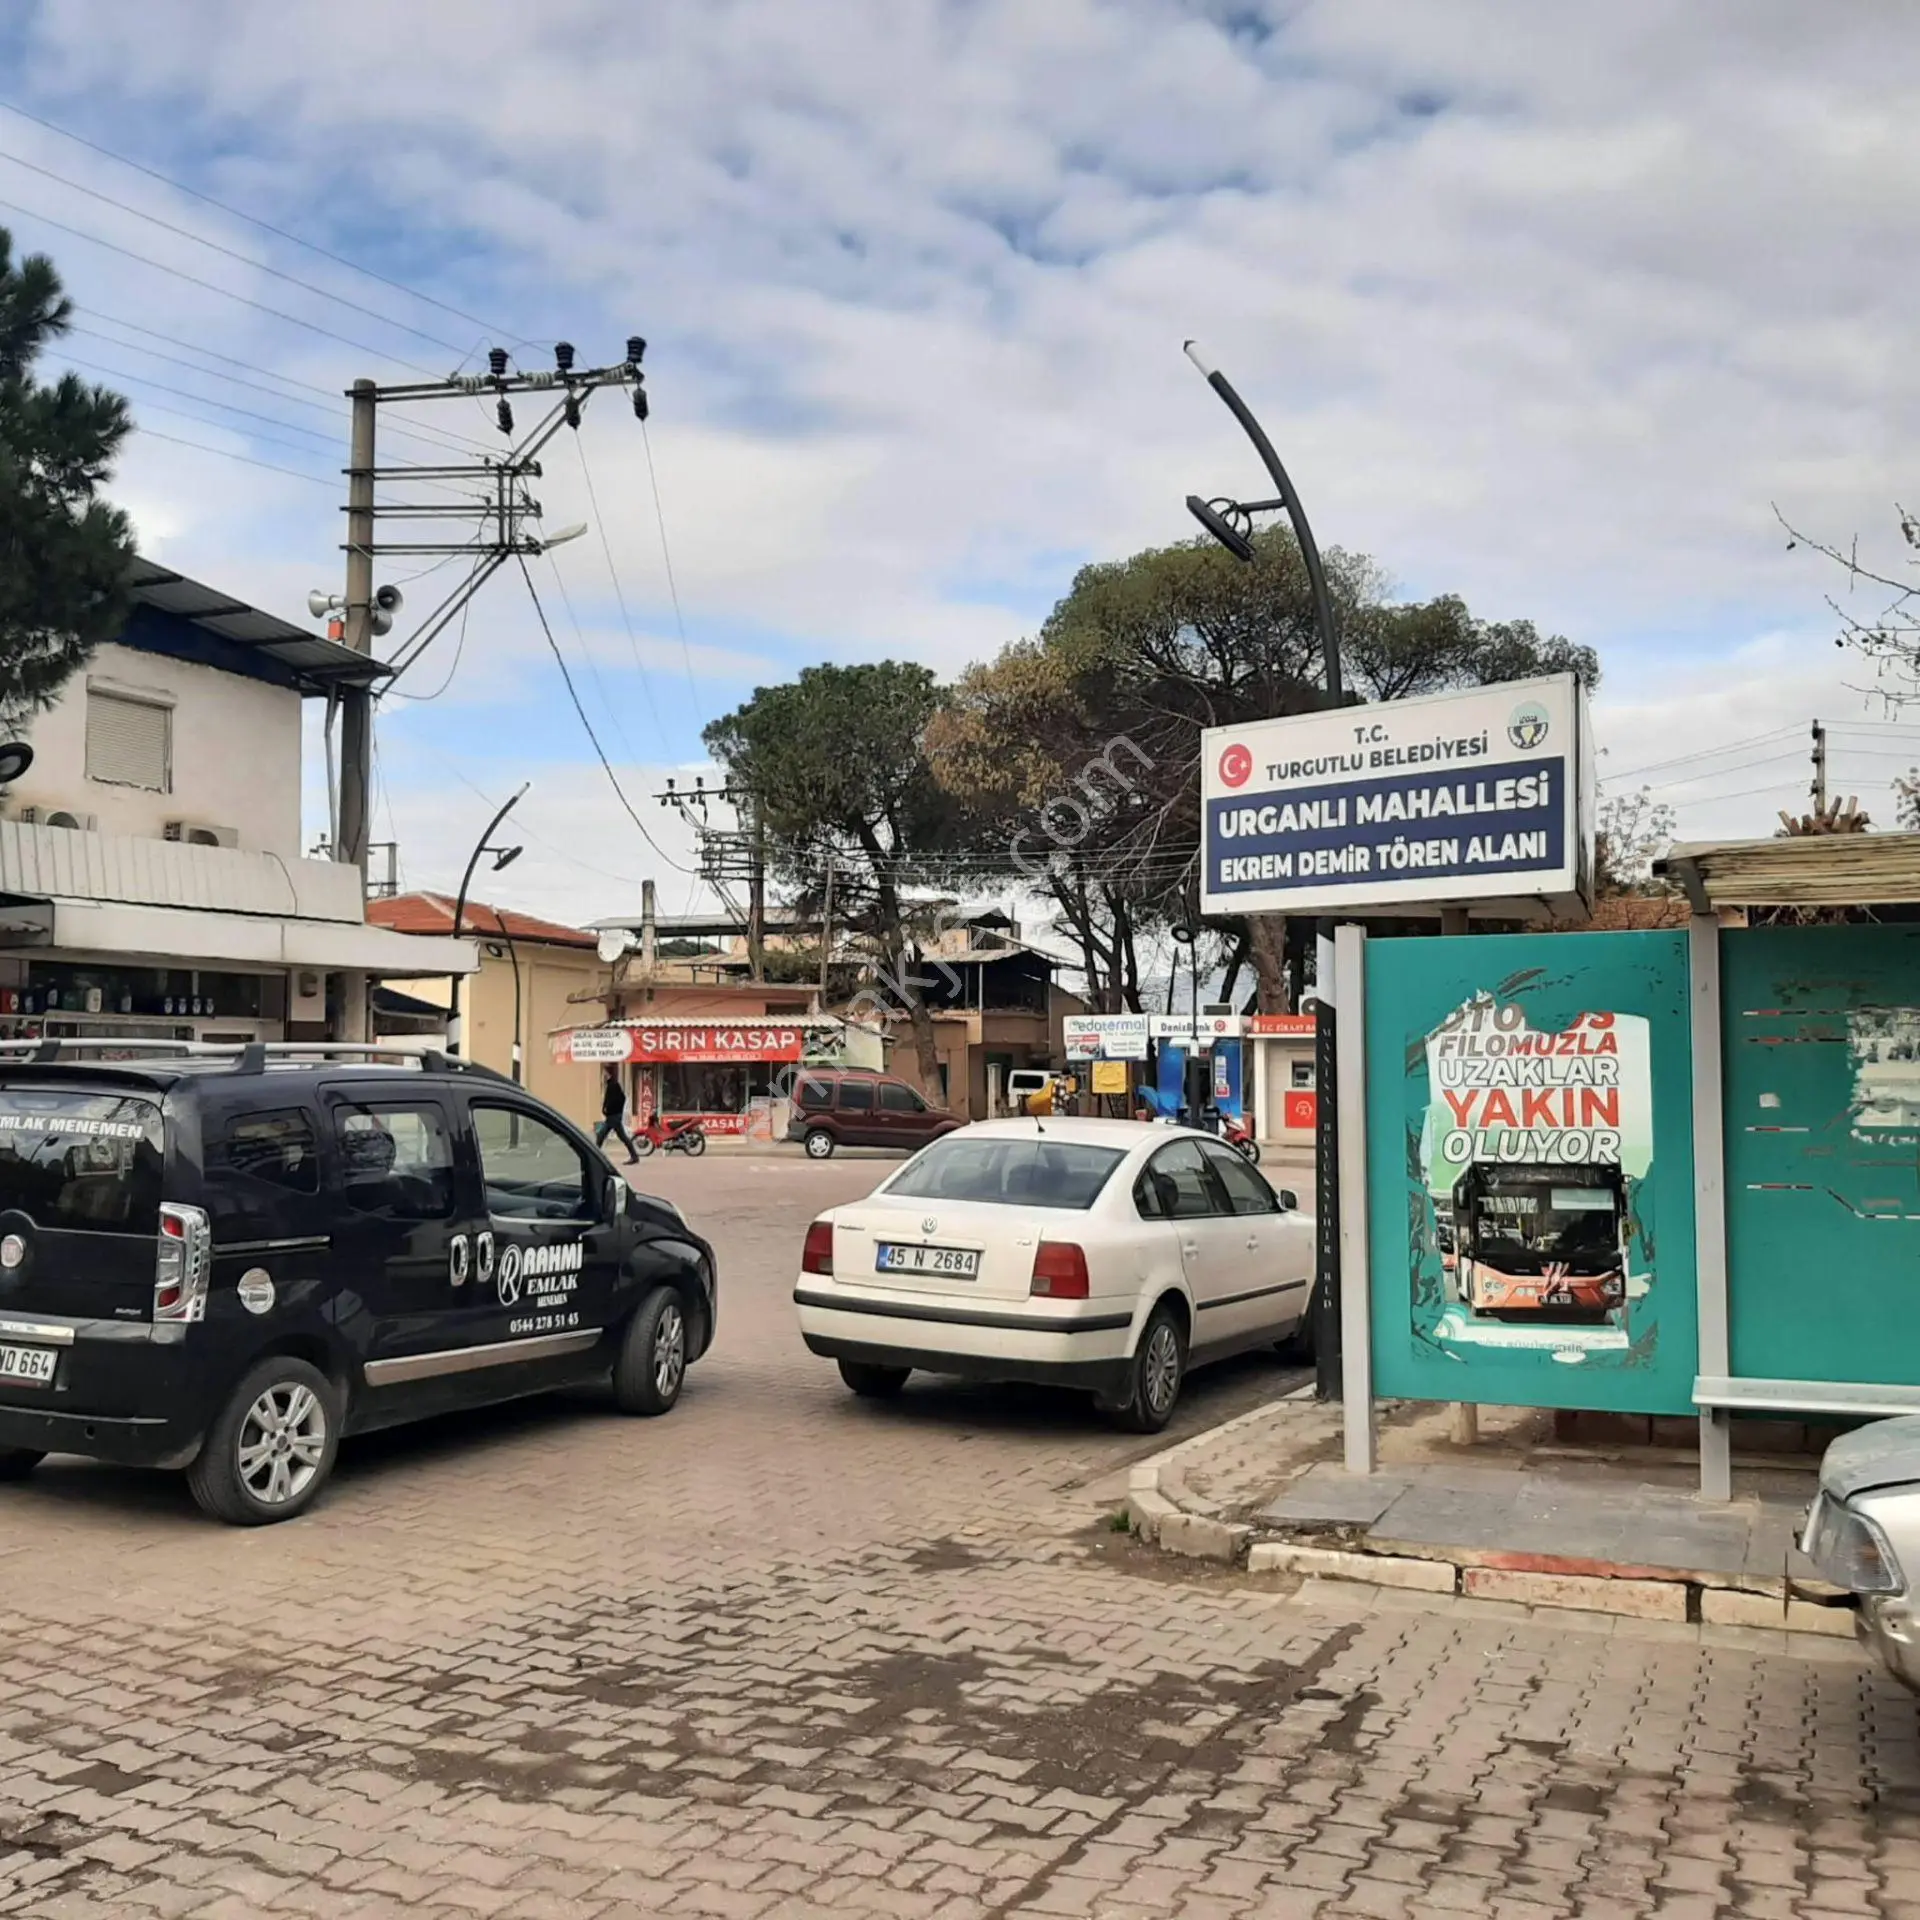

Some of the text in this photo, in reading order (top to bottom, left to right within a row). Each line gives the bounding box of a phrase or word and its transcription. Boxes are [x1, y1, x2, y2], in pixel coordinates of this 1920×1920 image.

[1354, 725, 1389, 745] T.C.
[1266, 729, 1488, 781] TURGUTLU BELEDİYESİ
[1219, 769, 1549, 838] URGANLI MAHALLESİ
[1220, 830, 1546, 883] EKREM DEMİR TÖREN ALANI
[1160, 1022, 1210, 1032] DenizBnk
[642, 1031, 797, 1054] ŞİRİN KASAP
[1438, 1029, 1618, 1057] FİLOMUZLA
[1438, 1056, 1619, 1088] UZAKLAR
[1442, 1087, 1620, 1128] YAKIN
[0, 1116, 144, 1139] MLAK MENEMEN
[1442, 1129, 1621, 1165] OLUYOR
[887, 1247, 973, 1271] 45 N 2684
[526, 1273, 578, 1295] EMLAK
[19, 1351, 49, 1377] 664
